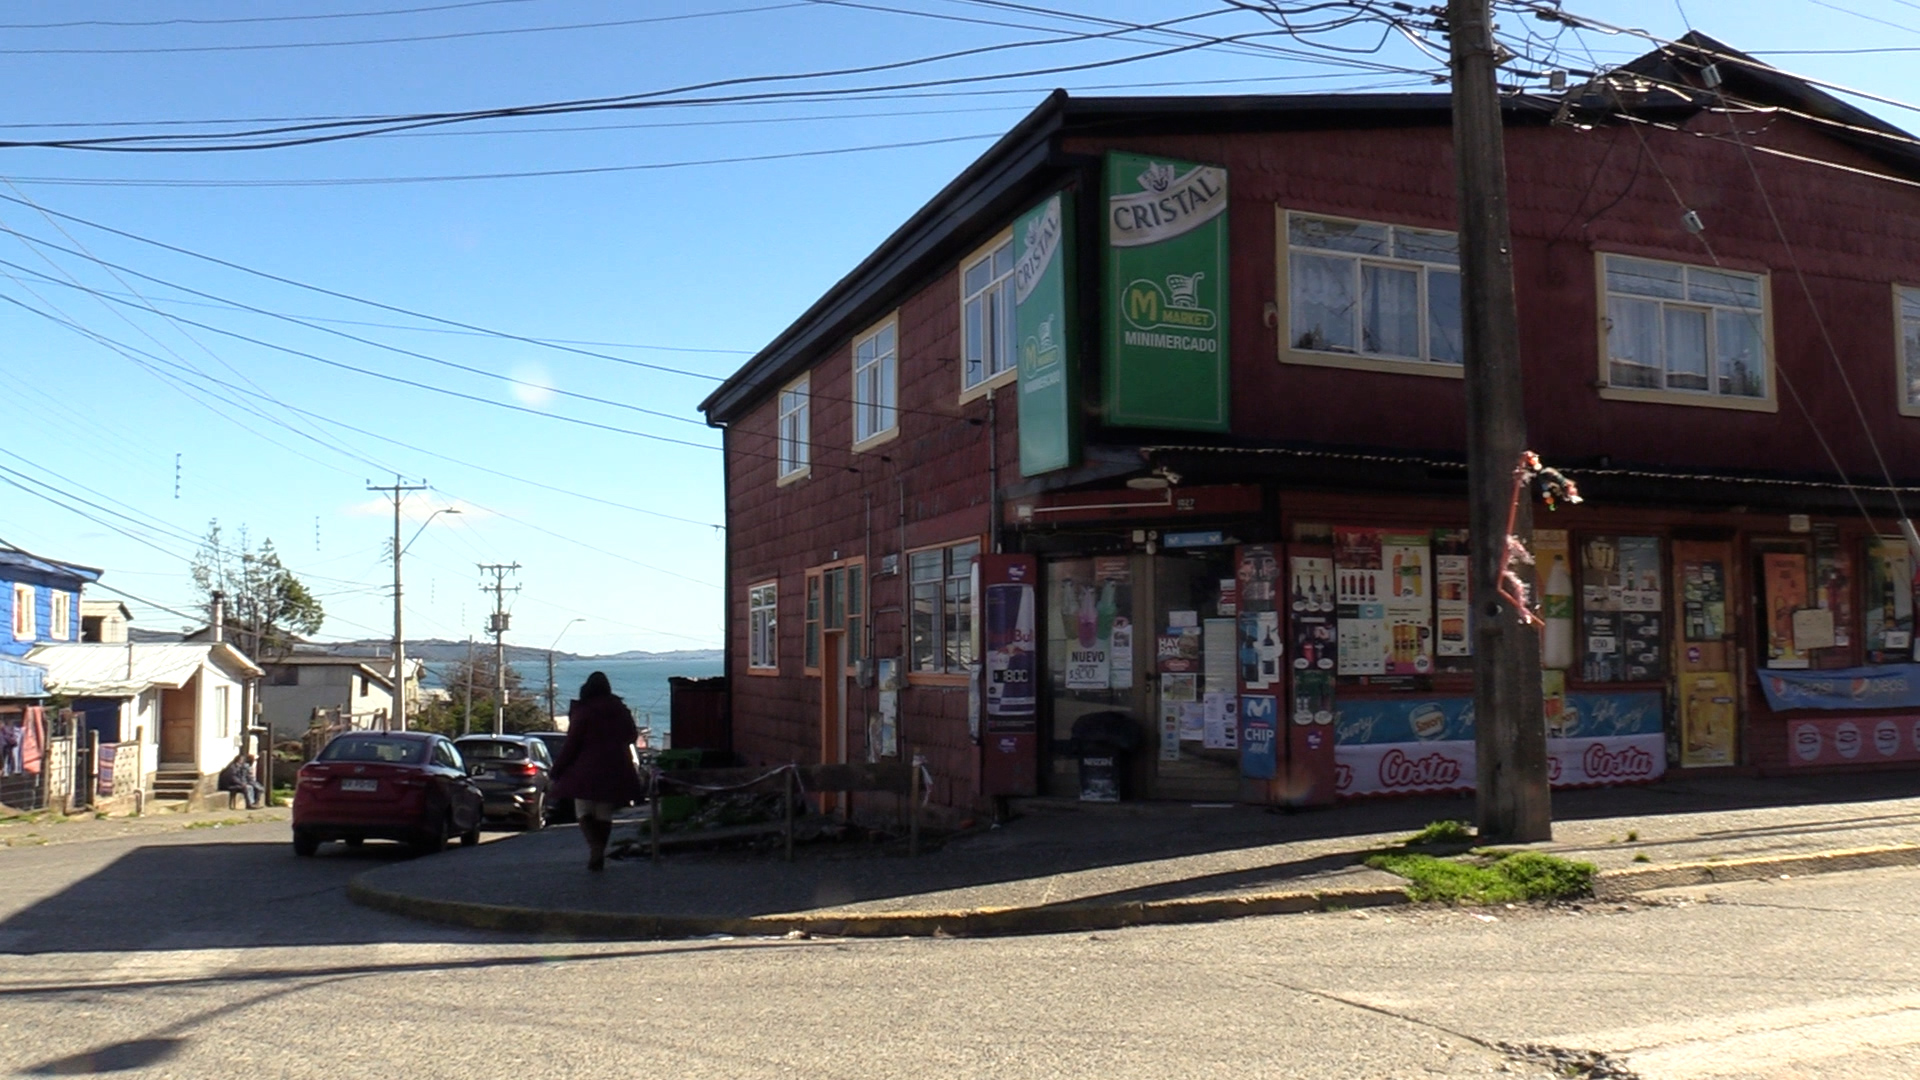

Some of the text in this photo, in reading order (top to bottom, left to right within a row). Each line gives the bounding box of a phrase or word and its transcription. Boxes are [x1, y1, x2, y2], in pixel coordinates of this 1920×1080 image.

[1113, 177, 1221, 231] CRISTAL
[1017, 216, 1059, 290] CRISTAL
[1129, 288, 1157, 321] M
[1162, 311, 1209, 327] MARKET
[1125, 331, 1217, 353] MINIMERCADO
[1158, 637, 1180, 647] HAY
[1072, 651, 1105, 662] NUEVO
[1871, 678, 1909, 692] pepsi
[1244, 728, 1275, 741] CHIP
[1379, 749, 1460, 787] Costa
[1583, 743, 1652, 778] Costa
